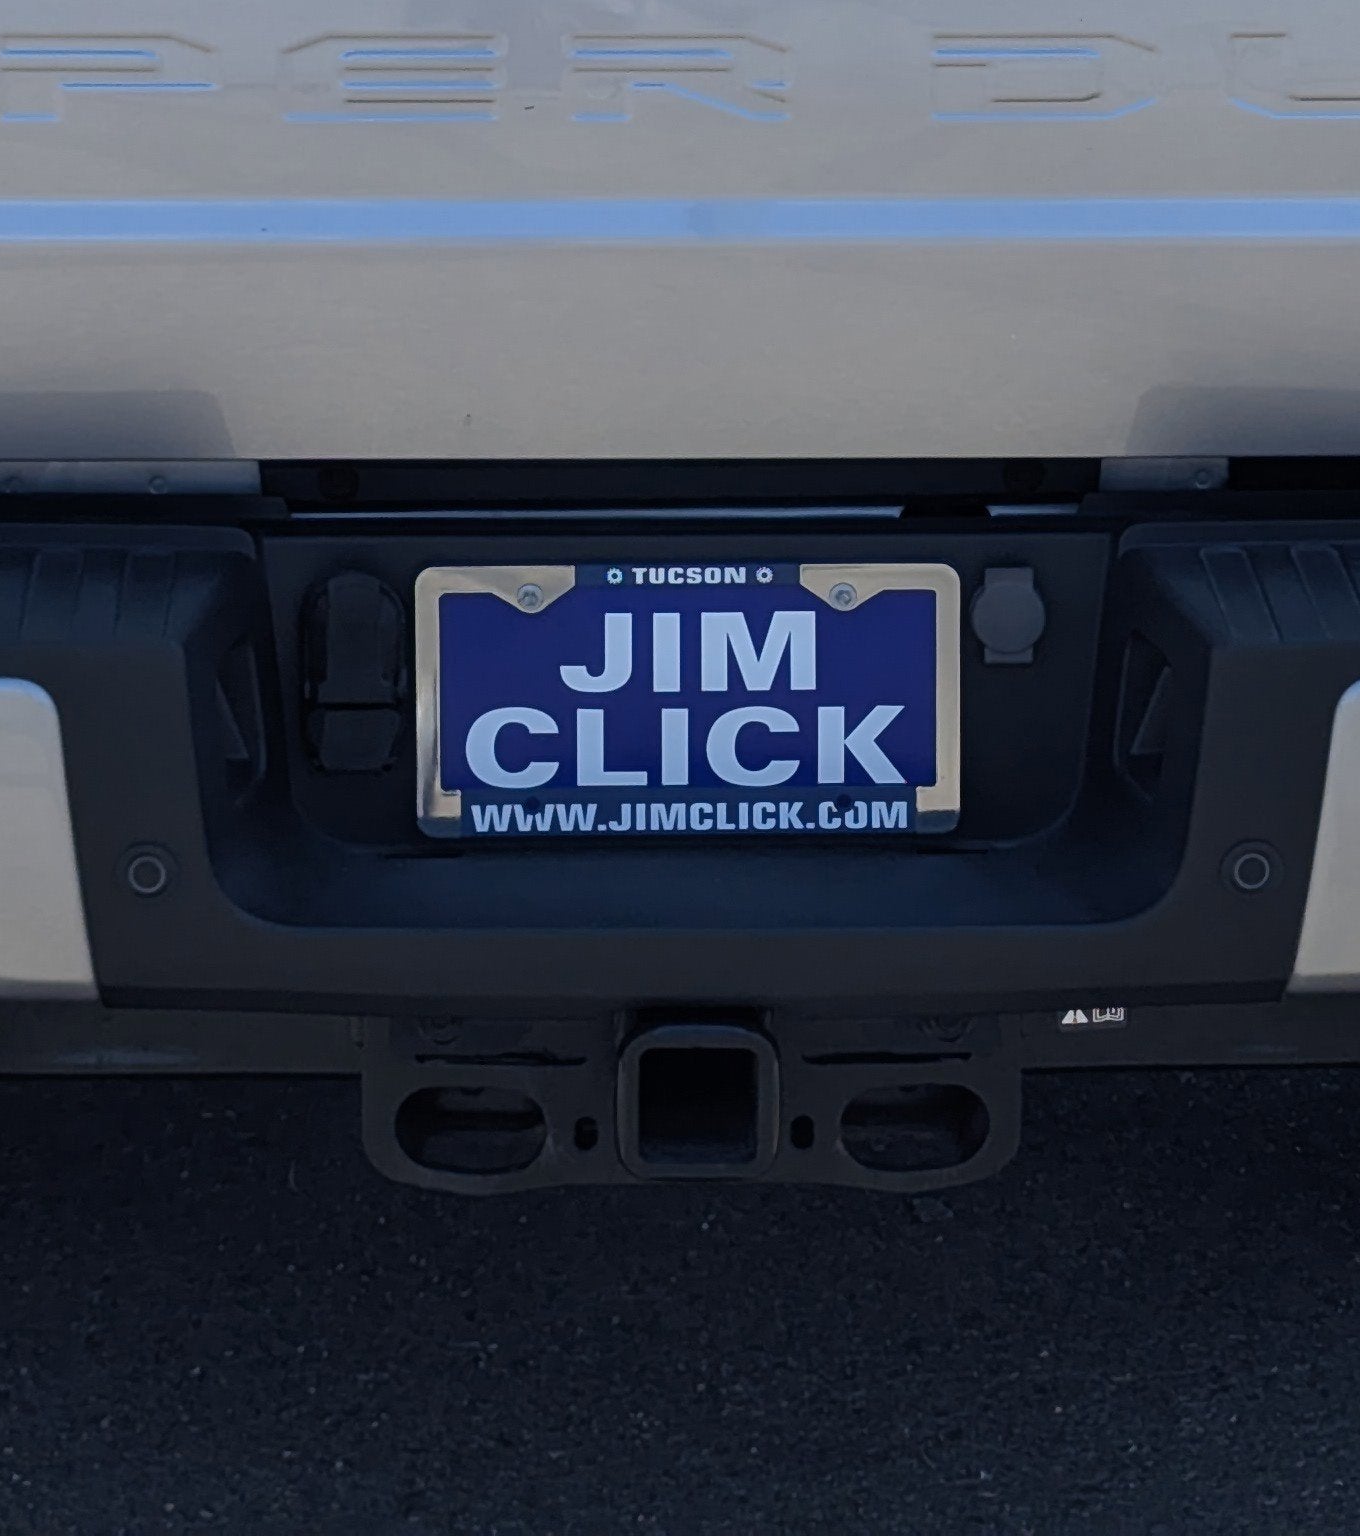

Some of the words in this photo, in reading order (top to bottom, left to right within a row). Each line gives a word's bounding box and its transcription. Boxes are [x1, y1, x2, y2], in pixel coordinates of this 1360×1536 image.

[631, 566, 747, 585] TUCSON
[559, 610, 818, 693] JIM
[465, 704, 907, 788] CLICK
[470, 800, 908, 833] WWW.JIMCLICK.COM
